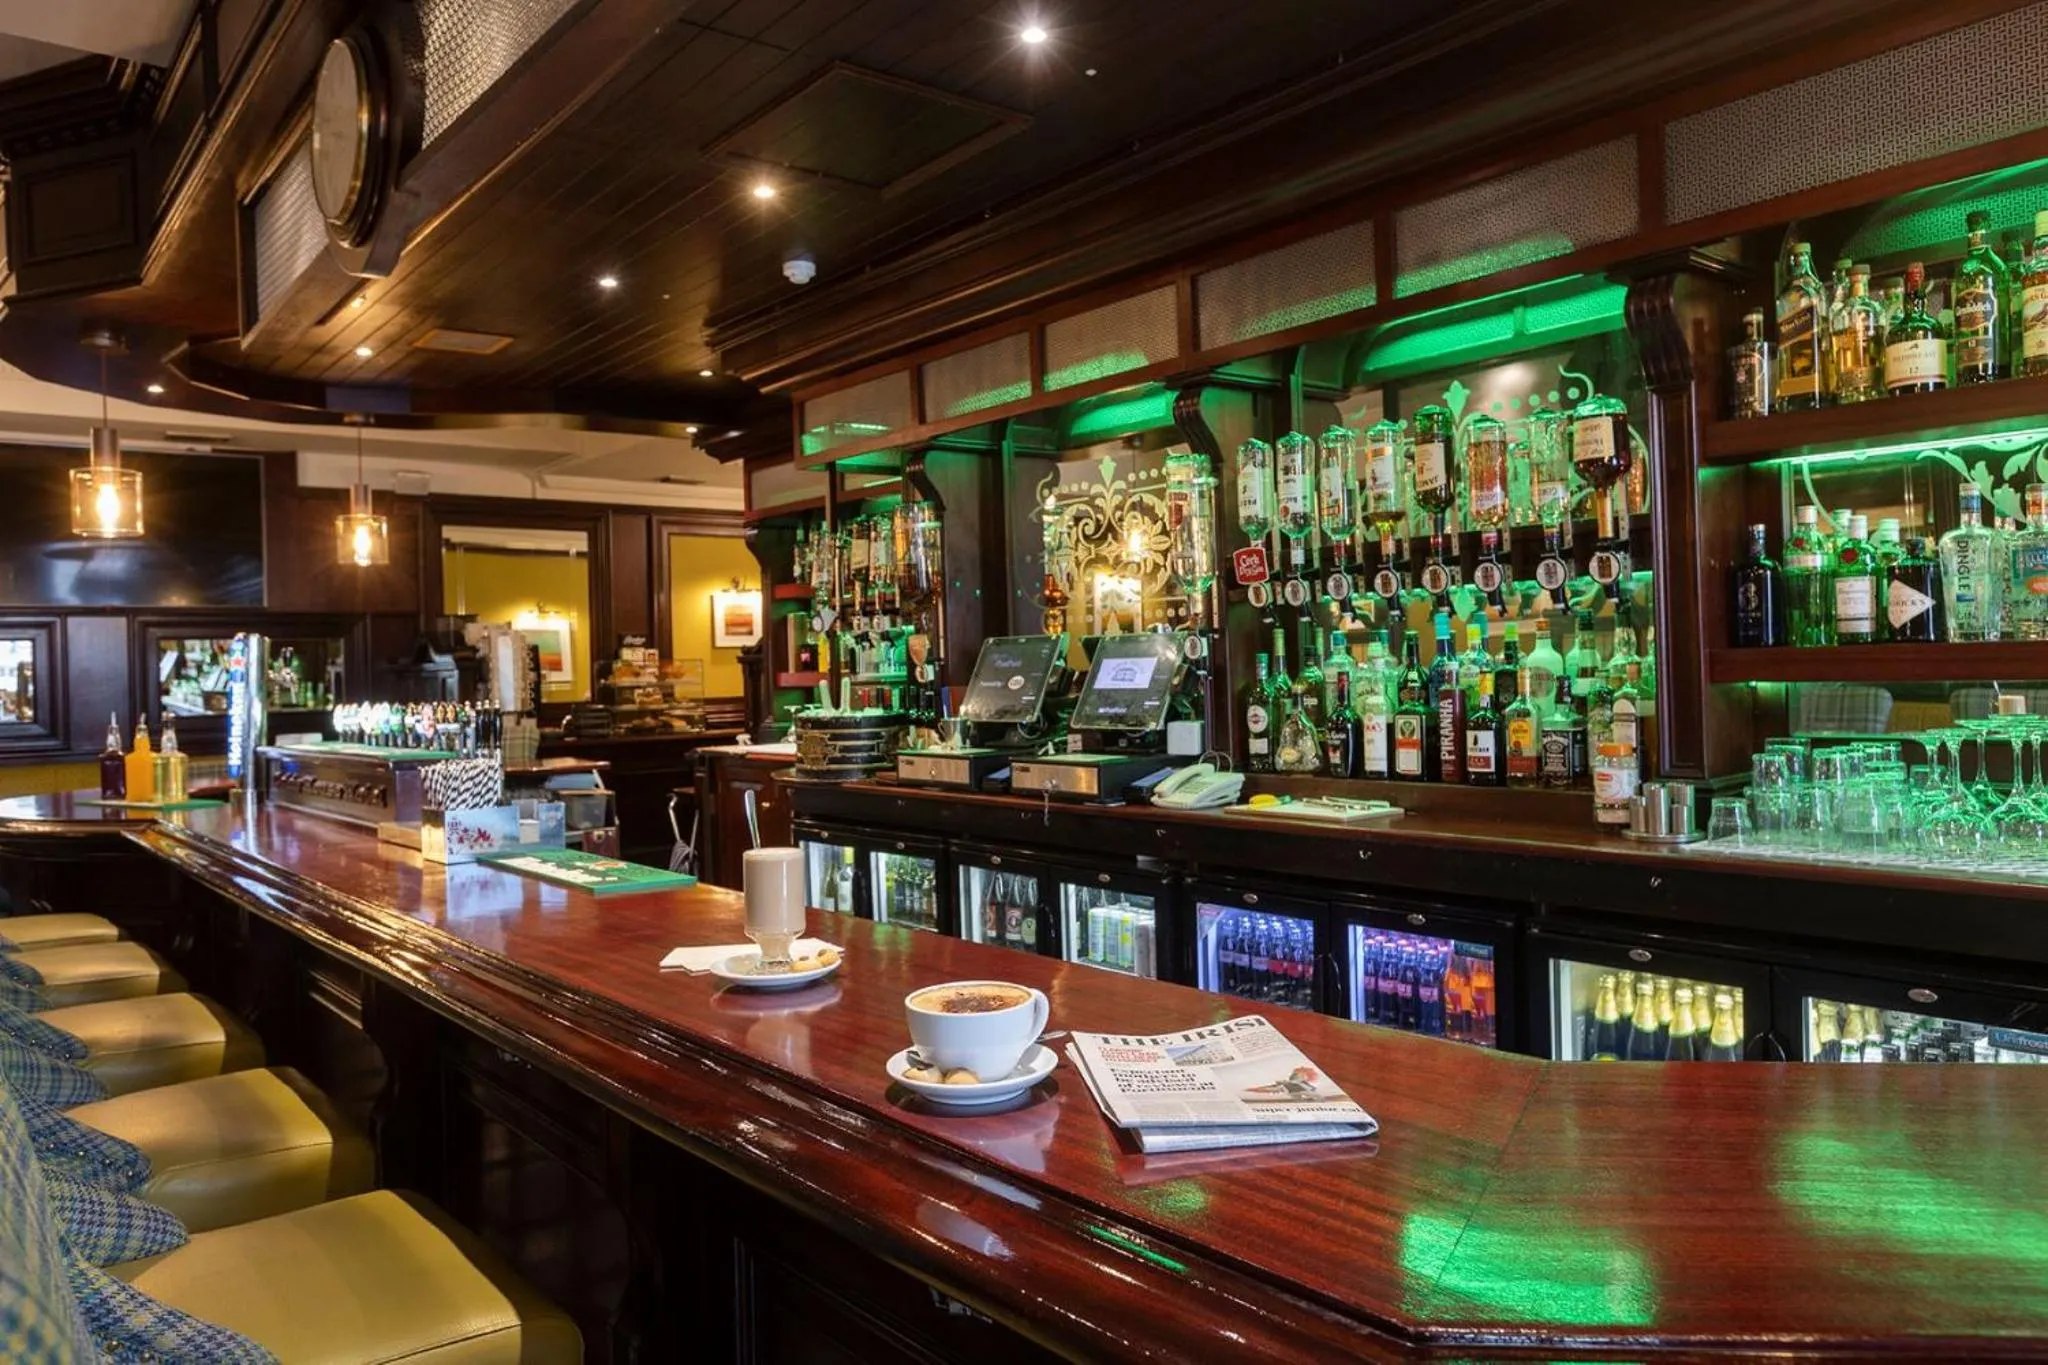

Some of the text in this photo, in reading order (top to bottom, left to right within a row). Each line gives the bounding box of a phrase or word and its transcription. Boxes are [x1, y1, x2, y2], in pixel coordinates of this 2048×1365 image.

[1957, 540, 1971, 591] DINGLE
[1440, 698, 1456, 760] PIRANHA
[1093, 1035, 1173, 1046] THE
